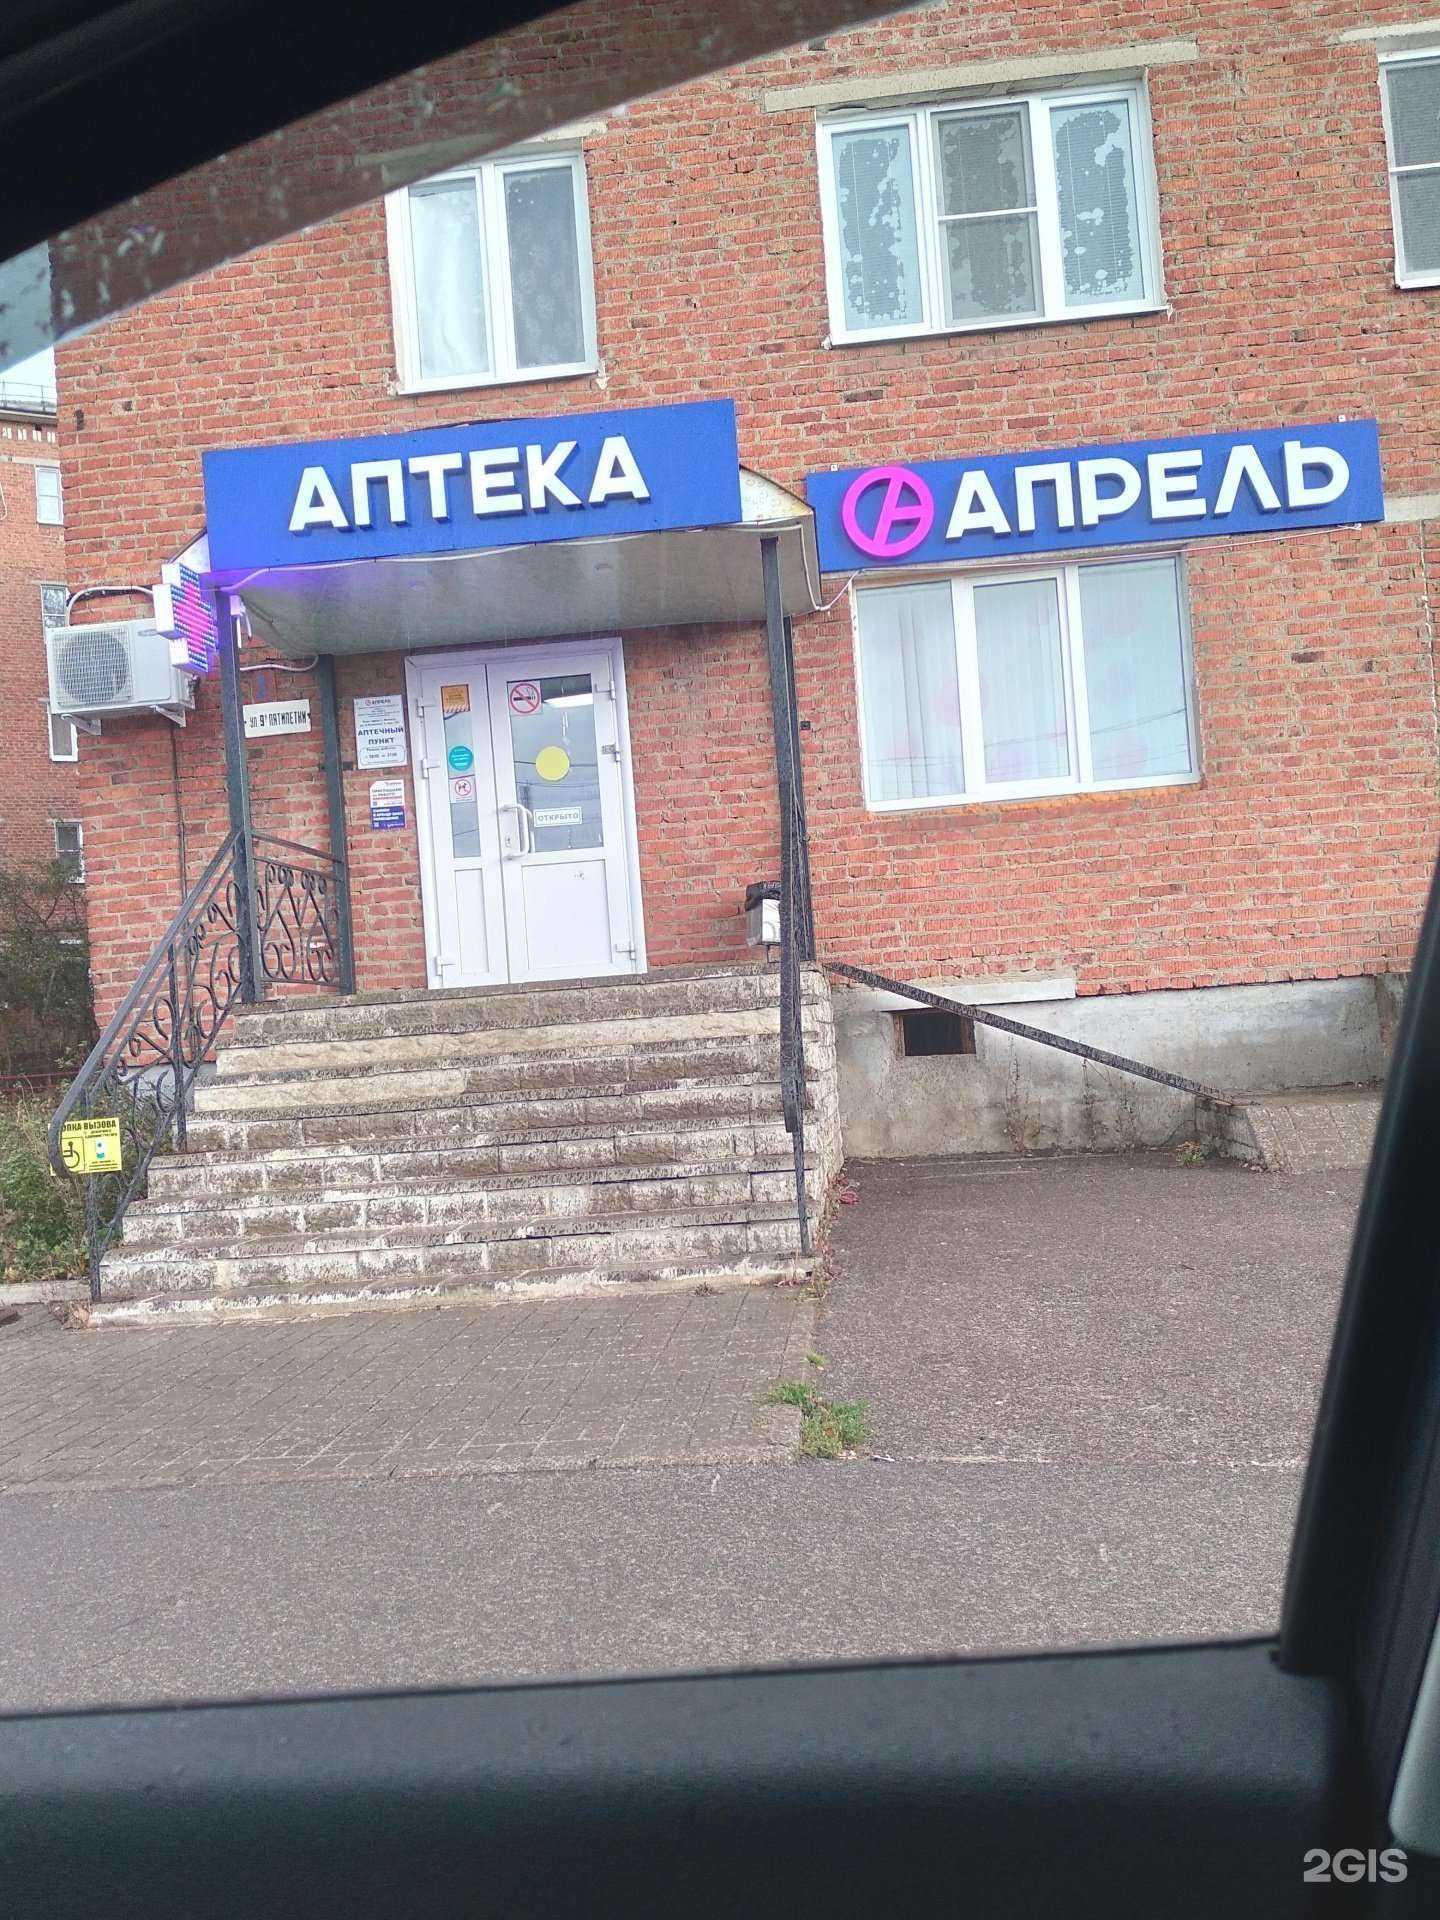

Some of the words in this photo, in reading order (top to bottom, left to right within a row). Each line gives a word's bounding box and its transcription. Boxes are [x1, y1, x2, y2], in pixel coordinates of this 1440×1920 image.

[288, 435, 651, 533] АПТЕКА
[944, 440, 1351, 542] АПРЕЛЬ
[269, 710, 307, 727] ПЯТИЛЕТКИ
[358, 727, 404, 737] АПТЕЧНЫЙ
[368, 737, 395, 745] ПУНКТ
[537, 812, 579, 822] ОТКРЫТО
[83, 1119, 117, 1130] ВЫЗОВА
